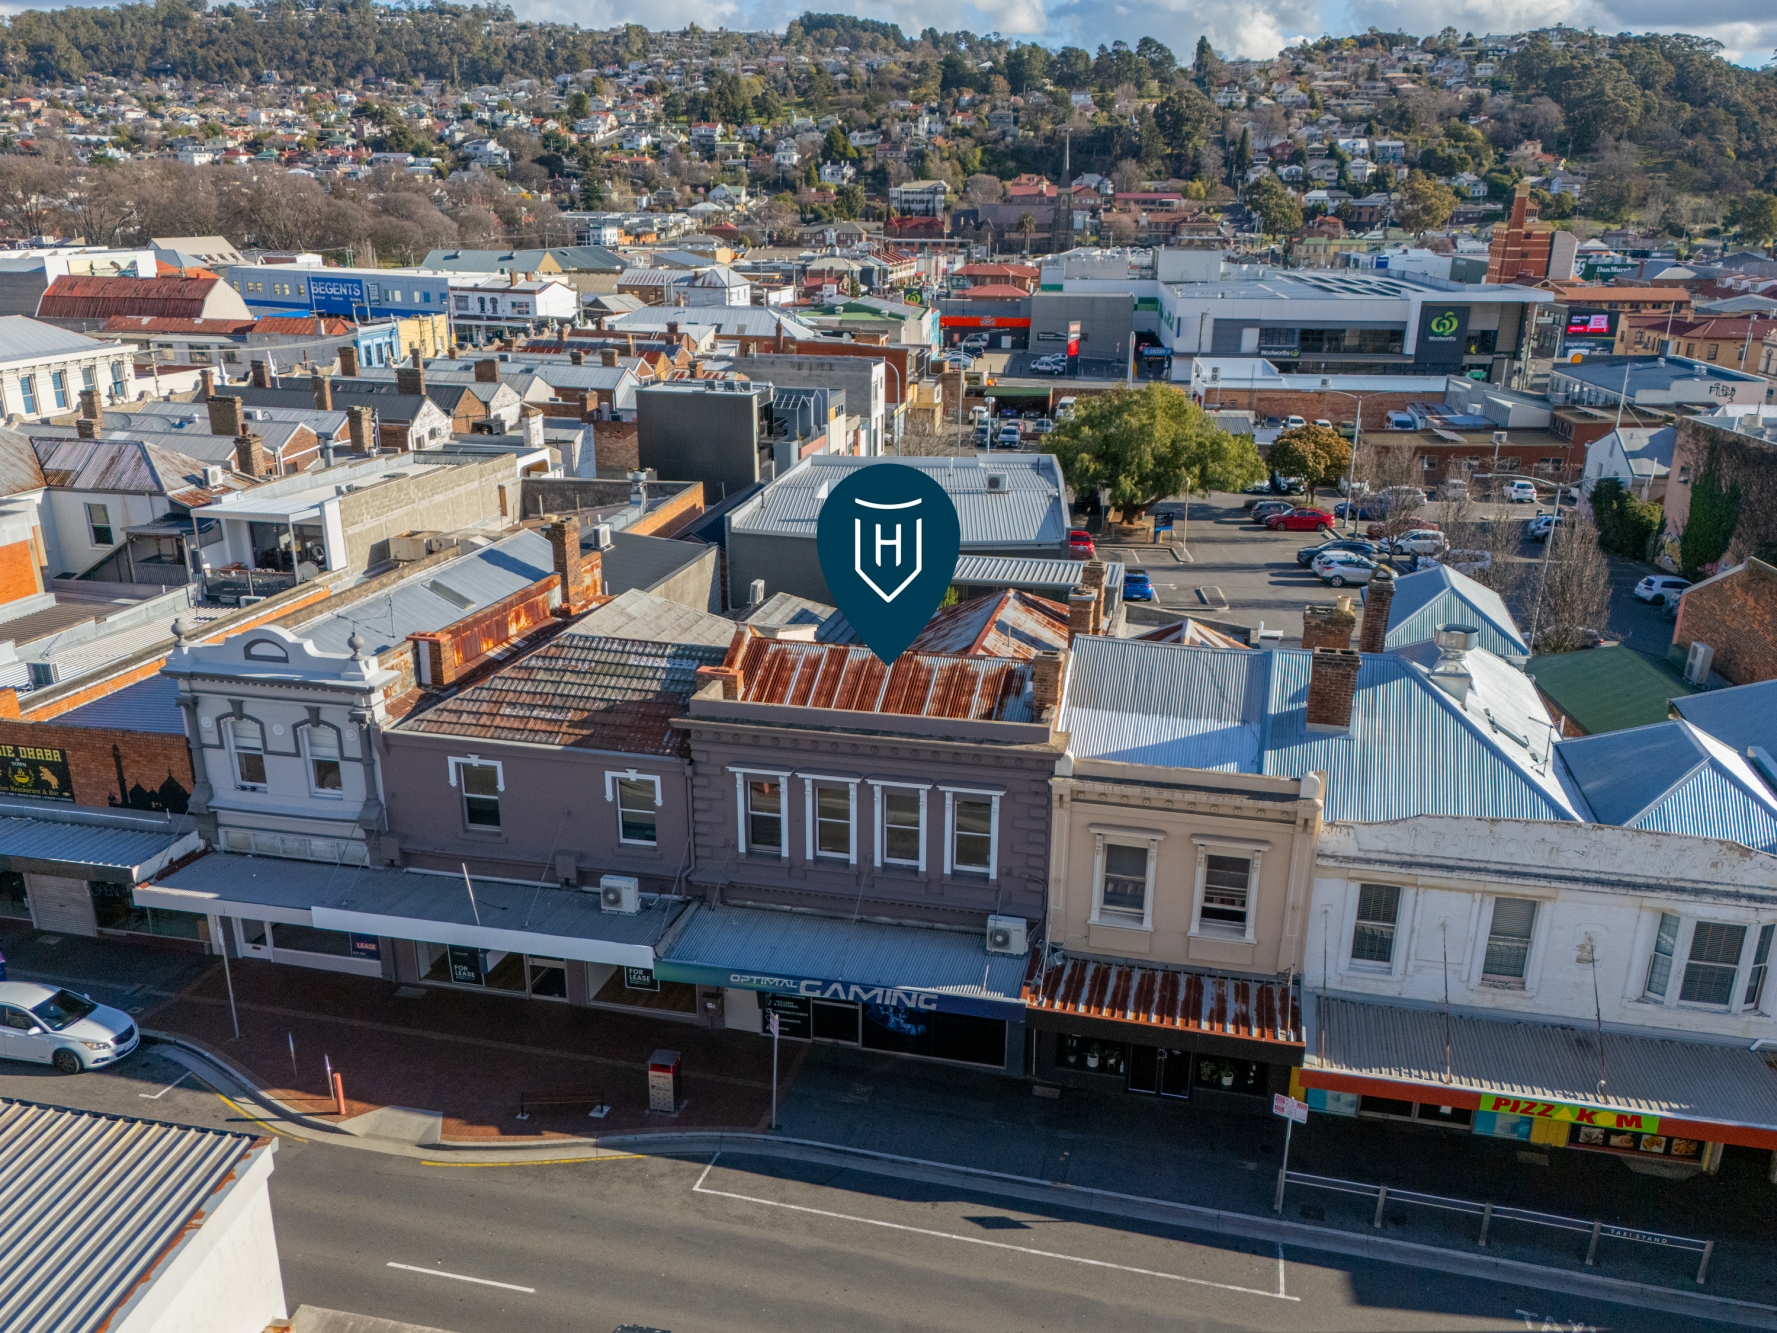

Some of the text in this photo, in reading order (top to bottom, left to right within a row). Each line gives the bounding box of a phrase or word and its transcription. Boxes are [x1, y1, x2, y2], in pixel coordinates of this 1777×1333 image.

[311, 281, 361, 296] BEGENTS
[18, 746, 62, 762] DHABA
[10, 785, 41, 795] Restaurant
[355, 942, 377, 950] LEASE
[454, 964, 468, 972] FOR
[629, 968, 644, 976] FOR
[455, 970, 476, 978] LEASE
[630, 974, 651, 982] LEASE
[730, 974, 939, 1011] OPTIMAL GAMING
[1611, 1229, 1668, 1244] TAXI STAND
